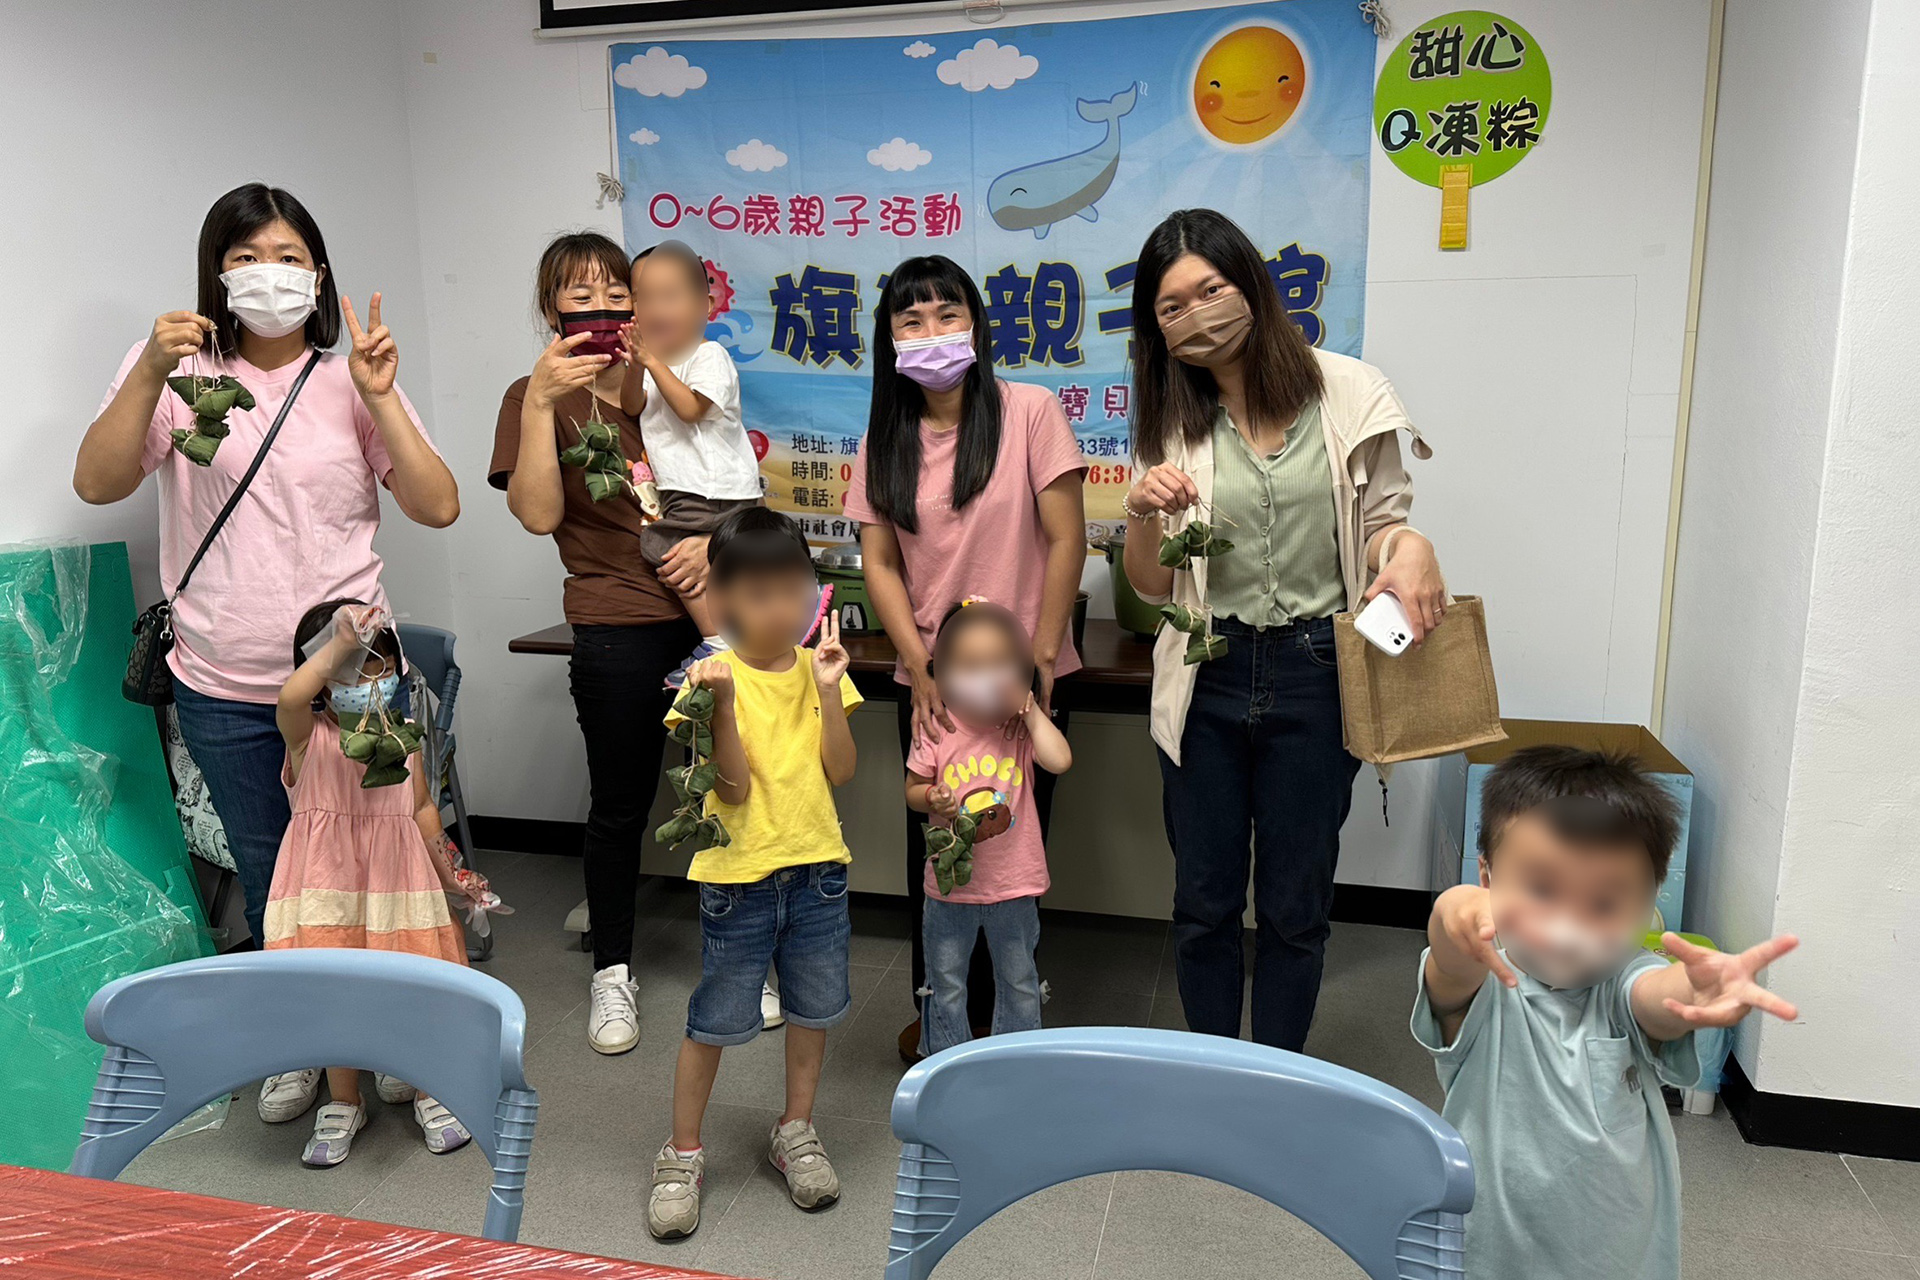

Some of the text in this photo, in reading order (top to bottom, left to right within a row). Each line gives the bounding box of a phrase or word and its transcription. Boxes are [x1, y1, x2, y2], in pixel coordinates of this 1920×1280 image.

[1409, 22, 1525, 79] 甜心
[1381, 97, 1540, 156] Q凍粽
[1089, 464, 1132, 485] 6:3
